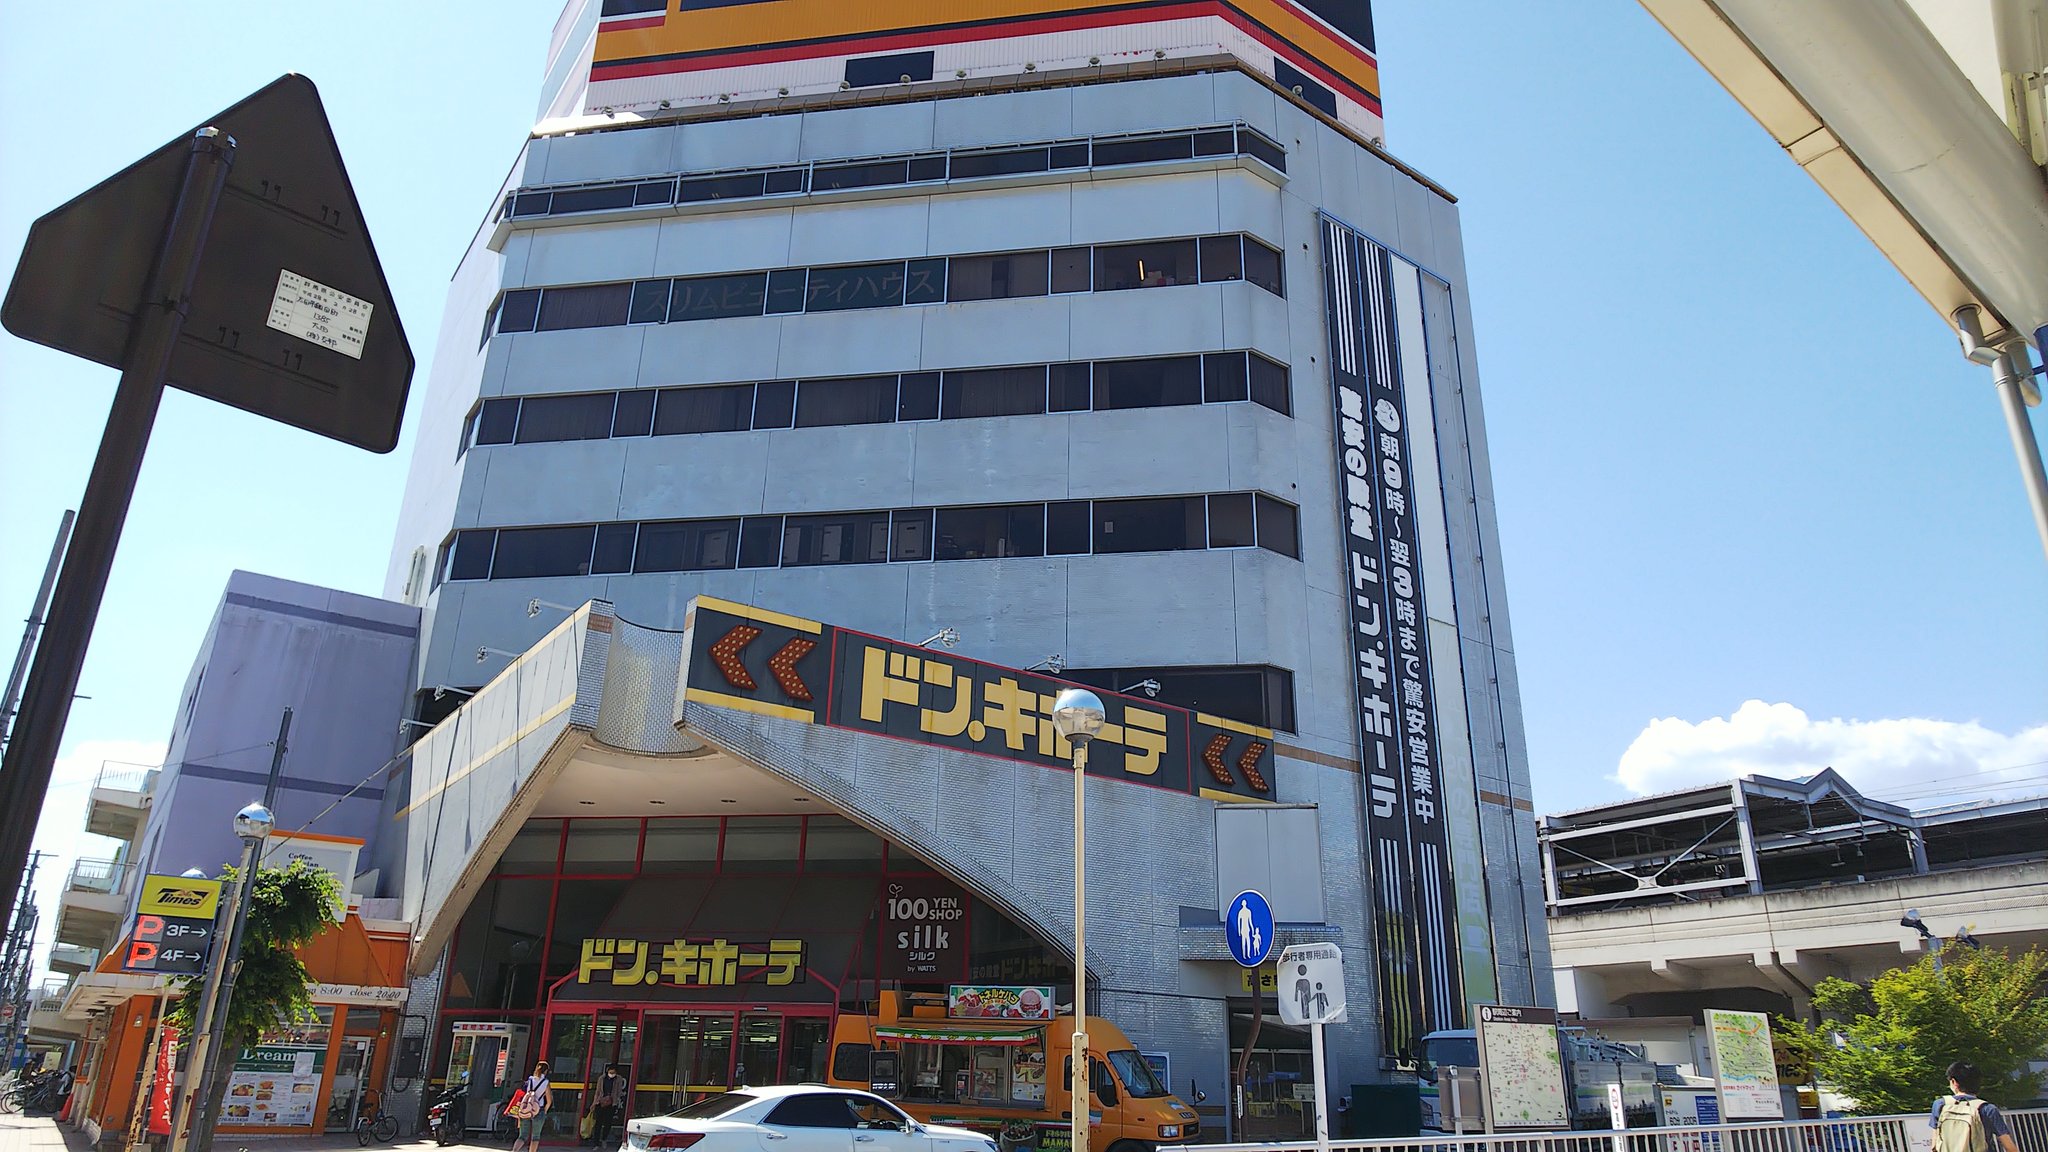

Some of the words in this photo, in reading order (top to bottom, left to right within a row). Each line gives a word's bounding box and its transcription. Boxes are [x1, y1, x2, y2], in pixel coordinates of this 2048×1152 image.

[157, 888, 208, 906] Times
[888, 898, 929, 920] 100
[932, 897, 957, 908] YEN
[929, 908, 963, 921] SHOP
[167, 924, 190, 937] 3F
[898, 925, 949, 949] silk
[160, 949, 185, 962] 4F
[909, 951, 935, 961] シルク
[907, 965, 916, 973] by
[917, 964, 937, 972] WATTS
[320, 986, 342, 995] 8:00
[349, 989, 372, 997] close
[375, 990, 401, 999] 20:00
